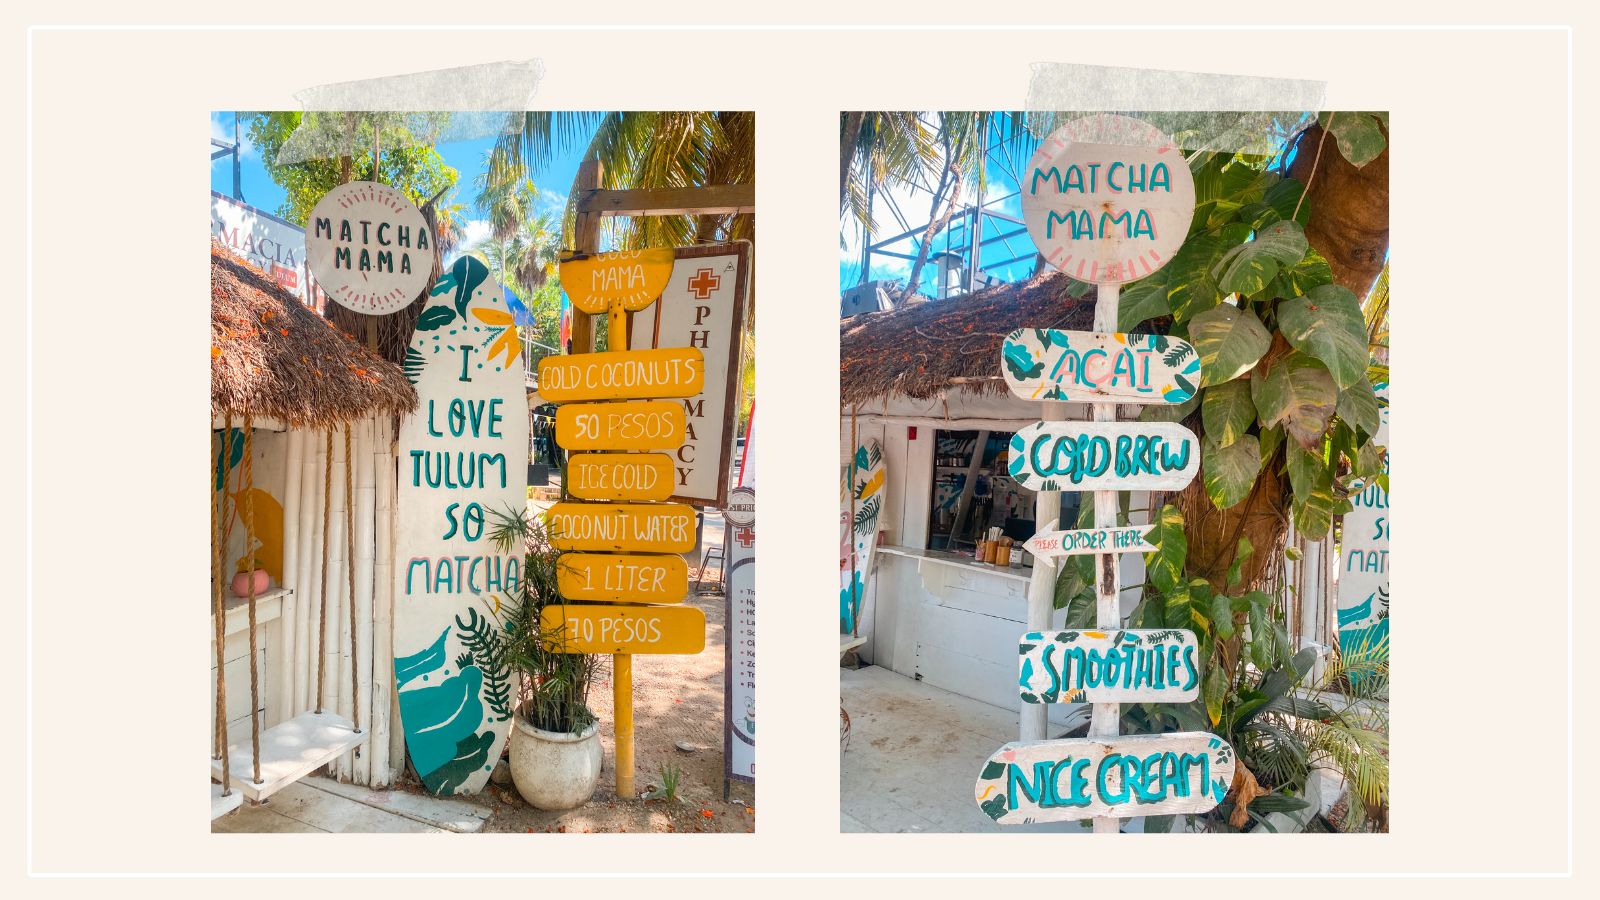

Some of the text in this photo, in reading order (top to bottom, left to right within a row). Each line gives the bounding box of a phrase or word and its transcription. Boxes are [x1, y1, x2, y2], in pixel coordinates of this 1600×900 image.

[1031, 161, 1173, 195] MATCHA
[314, 217, 428, 250] MATCHA
[1047, 208, 1158, 241] MAMA
[211, 221, 297, 268] MACIA
[335, 246, 412, 275] MAMA
[592, 264, 646, 292] MAMA
[458, 345, 474, 382] I
[541, 358, 696, 391] COLD COCONUTS
[676, 305, 711, 486] PHMACY
[427, 398, 504, 439] LOVE
[575, 412, 674, 439] 50 PESOS
[410, 449, 507, 489] TULUM
[1030, 433, 1191, 484] COLD BREW
[578, 463, 658, 490] ICE COLD
[442, 502, 485, 542] SO
[551, 513, 690, 543] COCONUT WATER
[1372, 516, 1389, 541] S
[1062, 531, 1107, 551] ORDER
[1109, 529, 1145, 550] THERE
[405, 555, 521, 595] MATCHA
[1346, 548, 1389, 574] MAT
[582, 564, 667, 593] 1 LITER
[567, 617, 663, 643] 70 PESOS
[1042, 643, 1199, 694] SMOOTHIES
[1007, 751, 1210, 811] NICE CREAM
